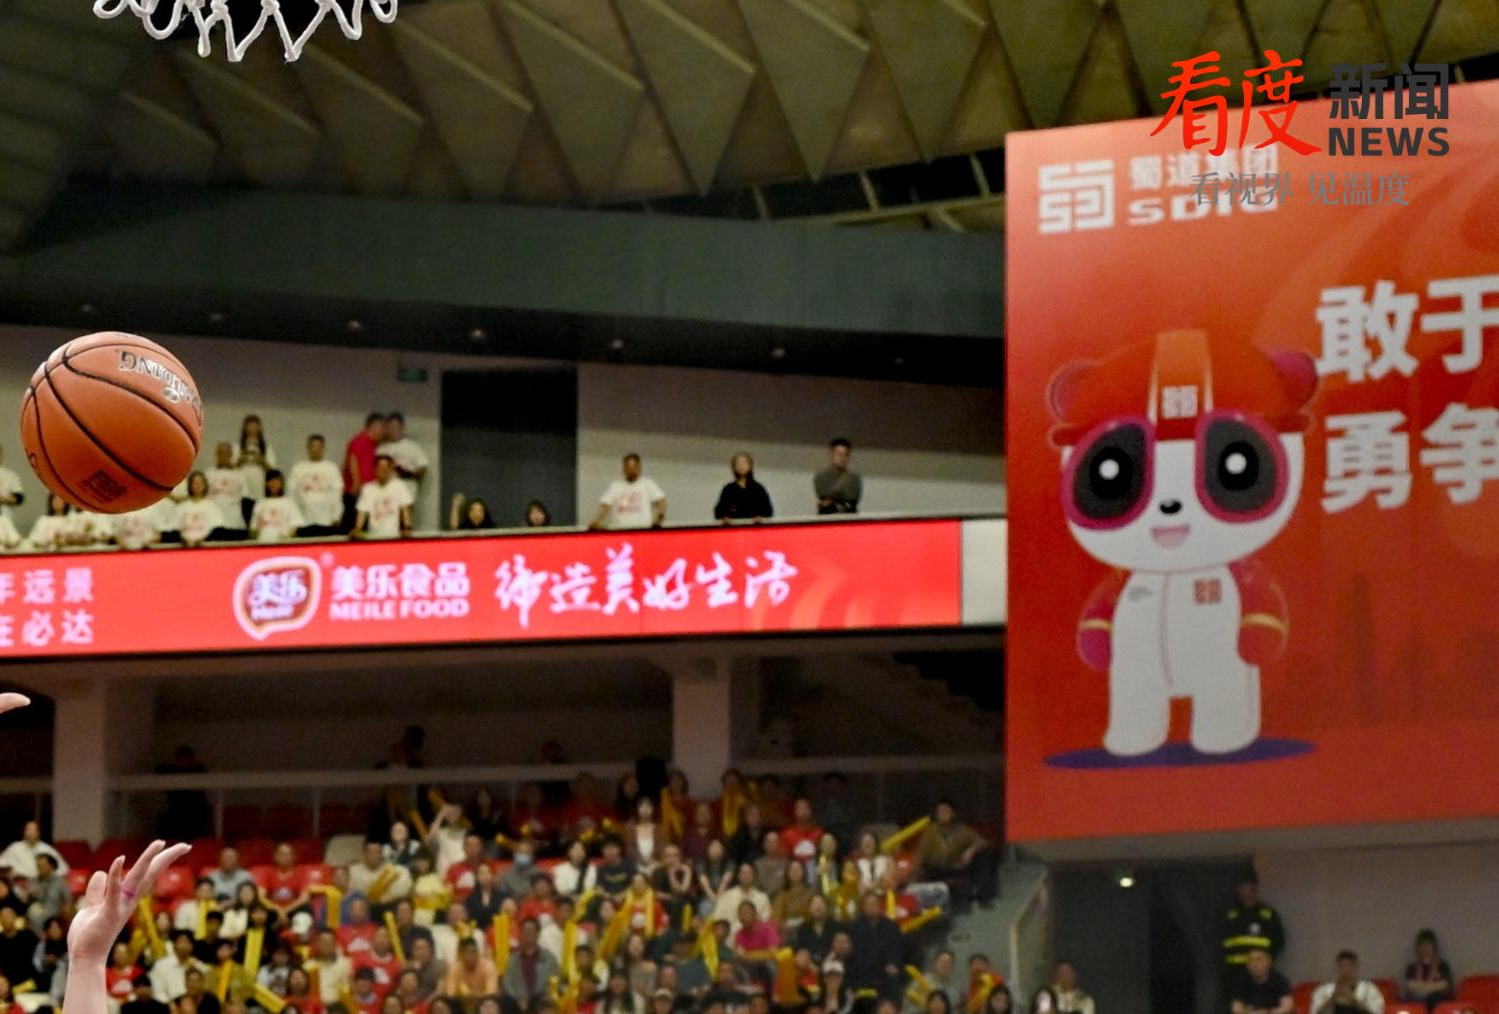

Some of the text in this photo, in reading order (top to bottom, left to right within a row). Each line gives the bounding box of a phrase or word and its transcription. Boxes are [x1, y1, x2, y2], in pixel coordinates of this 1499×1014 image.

[1315, 274, 1499, 383] 敢于
[1320, 402, 1499, 515] 勇争
[329, 599, 471, 621] MEILE FOOD
[330, 562, 471, 600] 美乐食品
